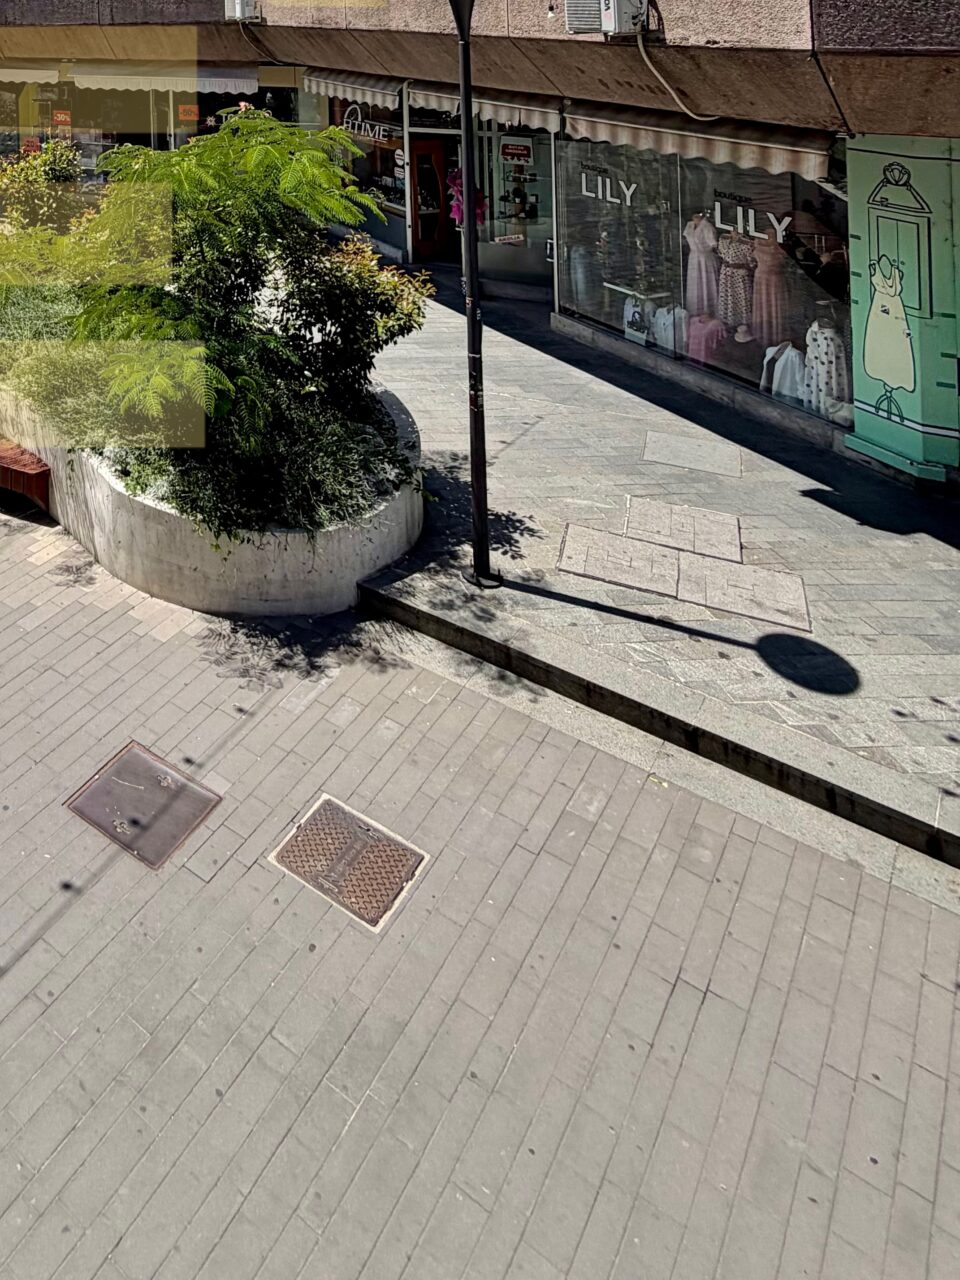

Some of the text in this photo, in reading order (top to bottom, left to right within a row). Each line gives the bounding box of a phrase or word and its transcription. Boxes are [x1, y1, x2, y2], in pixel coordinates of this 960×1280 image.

[581, 172, 638, 207] LILY
[714, 188, 753, 204] boutique
[714, 201, 793, 244] LILY
